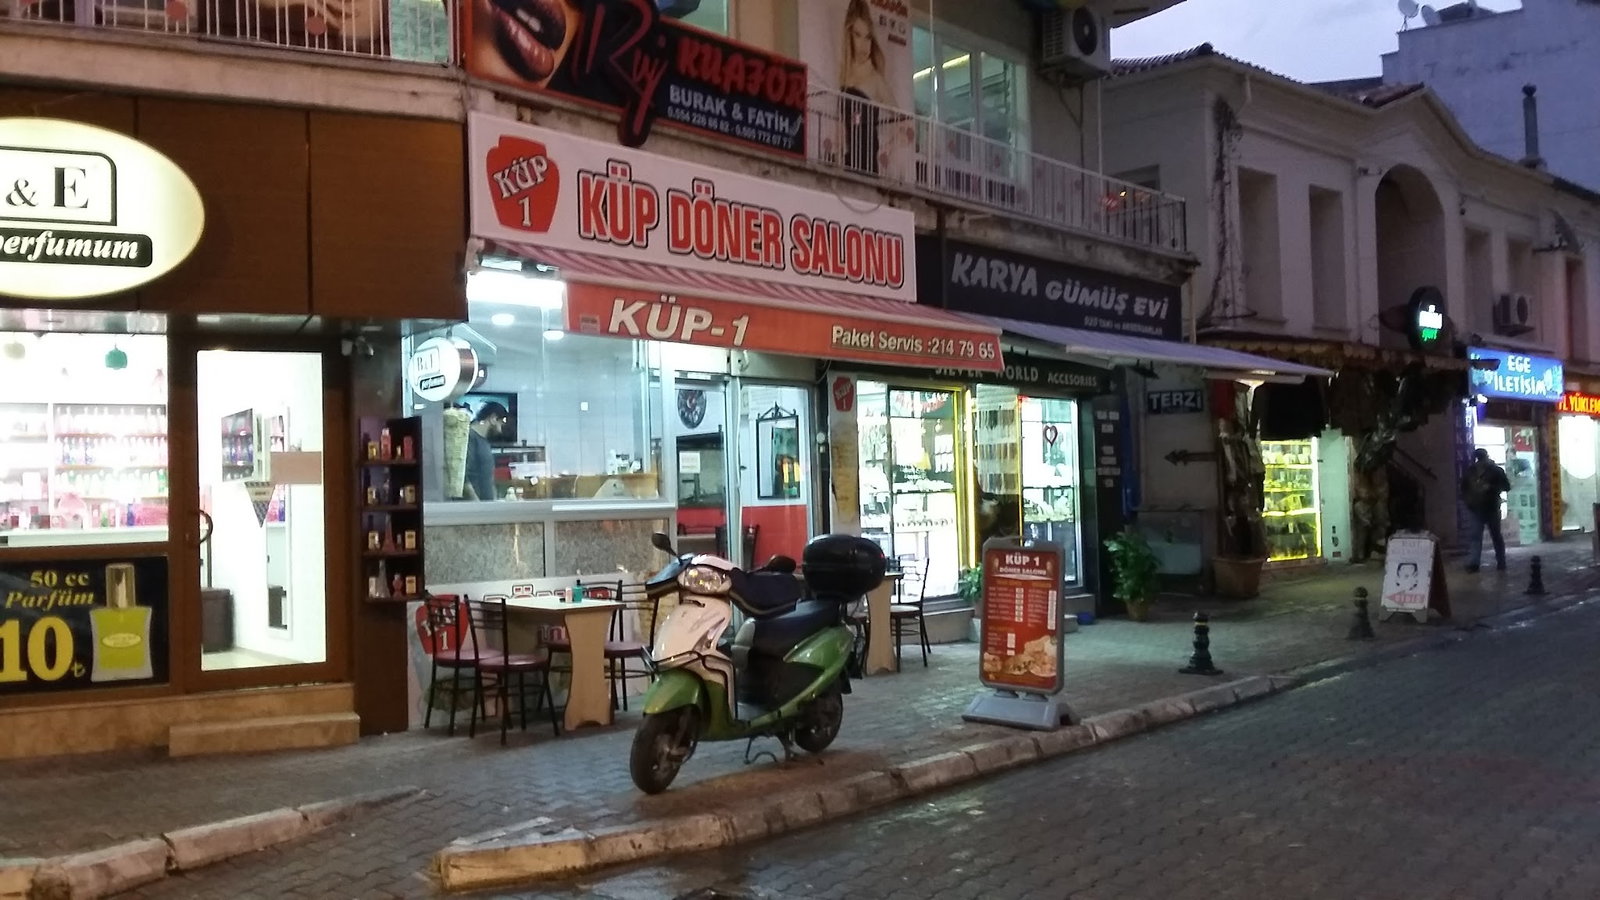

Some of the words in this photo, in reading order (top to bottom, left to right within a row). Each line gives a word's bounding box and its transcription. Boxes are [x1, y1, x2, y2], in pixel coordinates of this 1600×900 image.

[670, 84, 727, 117] BURAK
[731, 102, 743, 121] &
[748, 108, 789, 134] FATİH
[5, 178, 38, 207] &
[54, 167, 89, 209] E
[493, 155, 548, 199] KÜP
[518, 196, 532, 227] 1
[577, 158, 659, 249] KÜP
[667, 178, 784, 271] DÖNER
[790, 213, 905, 289] SALONU
[0, 230, 138, 261] erfumum
[951, 252, 1038, 297] KARYA
[1045, 278, 1129, 316] GÜMÜŞ
[1134, 296, 1168, 320] EVİ
[608, 295, 750, 347] KÜP-1
[832, 325, 874, 348] Paket
[879, 332, 923, 353] Servis
[959, 340, 974, 358] 79
[979, 341, 995, 359] 65
[1507, 355, 1531, 374] EGE
[1005, 552, 1030, 565] KÜP
[1033, 556, 1040, 566] 1
[30, 569, 58, 588] 50
[65, 571, 89, 587] cc
[5, 589, 94, 611] Parfüm
